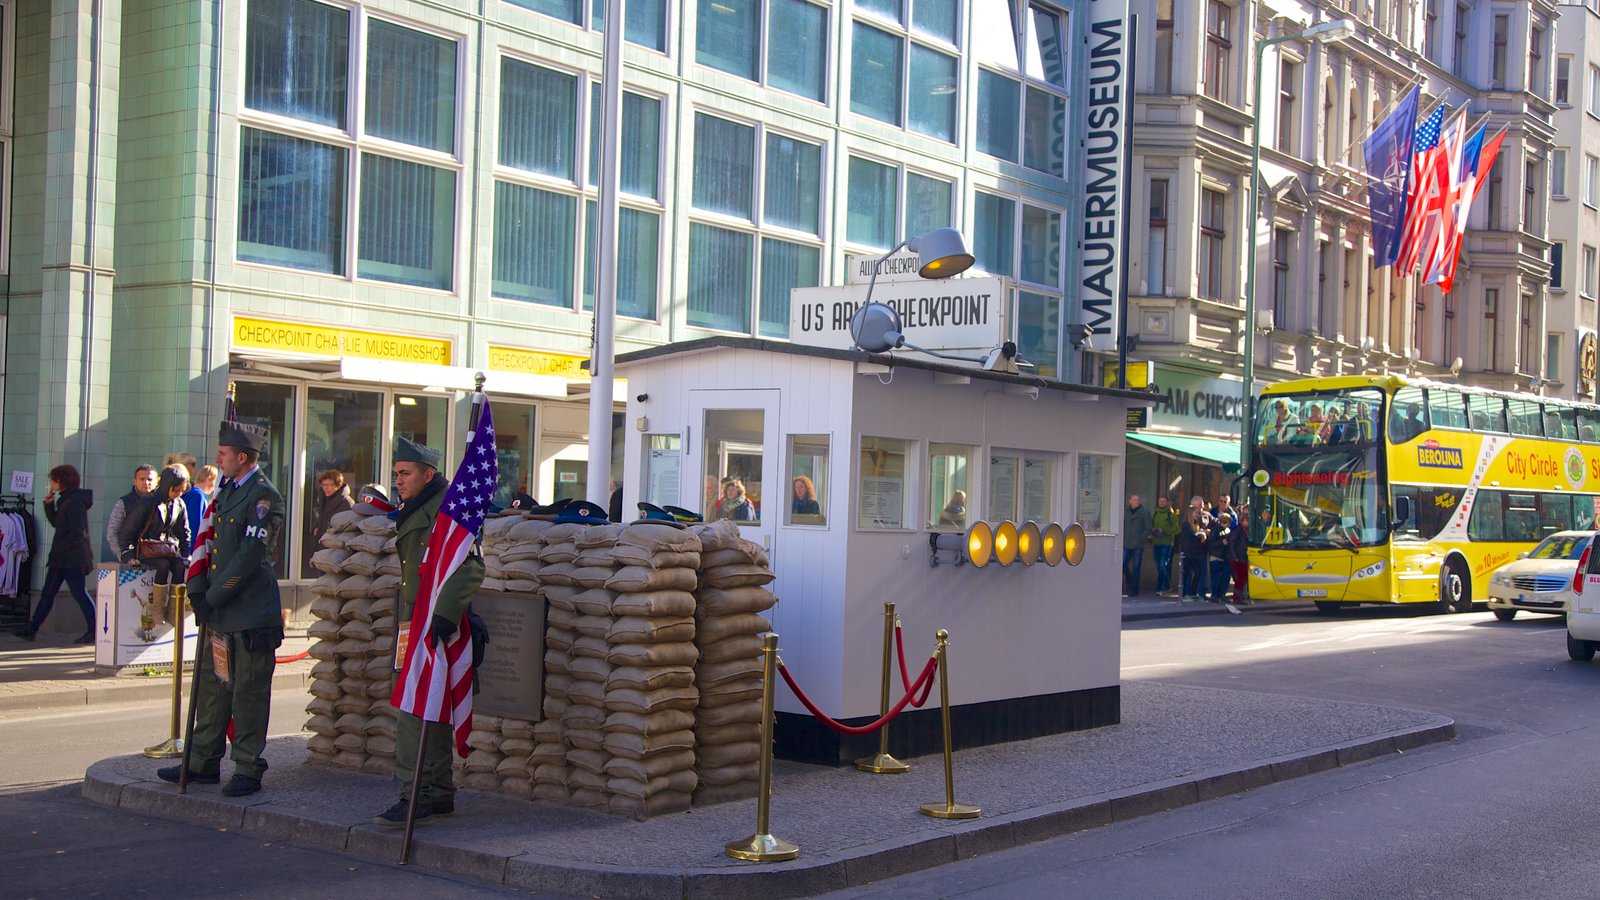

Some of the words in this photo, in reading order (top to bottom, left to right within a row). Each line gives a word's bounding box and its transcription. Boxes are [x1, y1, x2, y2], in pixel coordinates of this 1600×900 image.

[1082, 18, 1122, 335] MAUERMUSEUM
[801, 303, 824, 332] US
[238, 324, 313, 348] CHECKPOINT
[315, 332, 361, 354] CHARLIE
[365, 339, 447, 361] MUSEUMSSHOP
[491, 353, 548, 371] CHECKPOINT
[1164, 387, 1190, 416] AM
[1506, 451, 1526, 480] City
[1529, 453, 1558, 477] Circle
[1274, 469, 1349, 488] Sightseeing
[245, 525, 268, 539] MP
[1268, 530, 1281, 541] 11
[1483, 553, 1492, 568] 10
